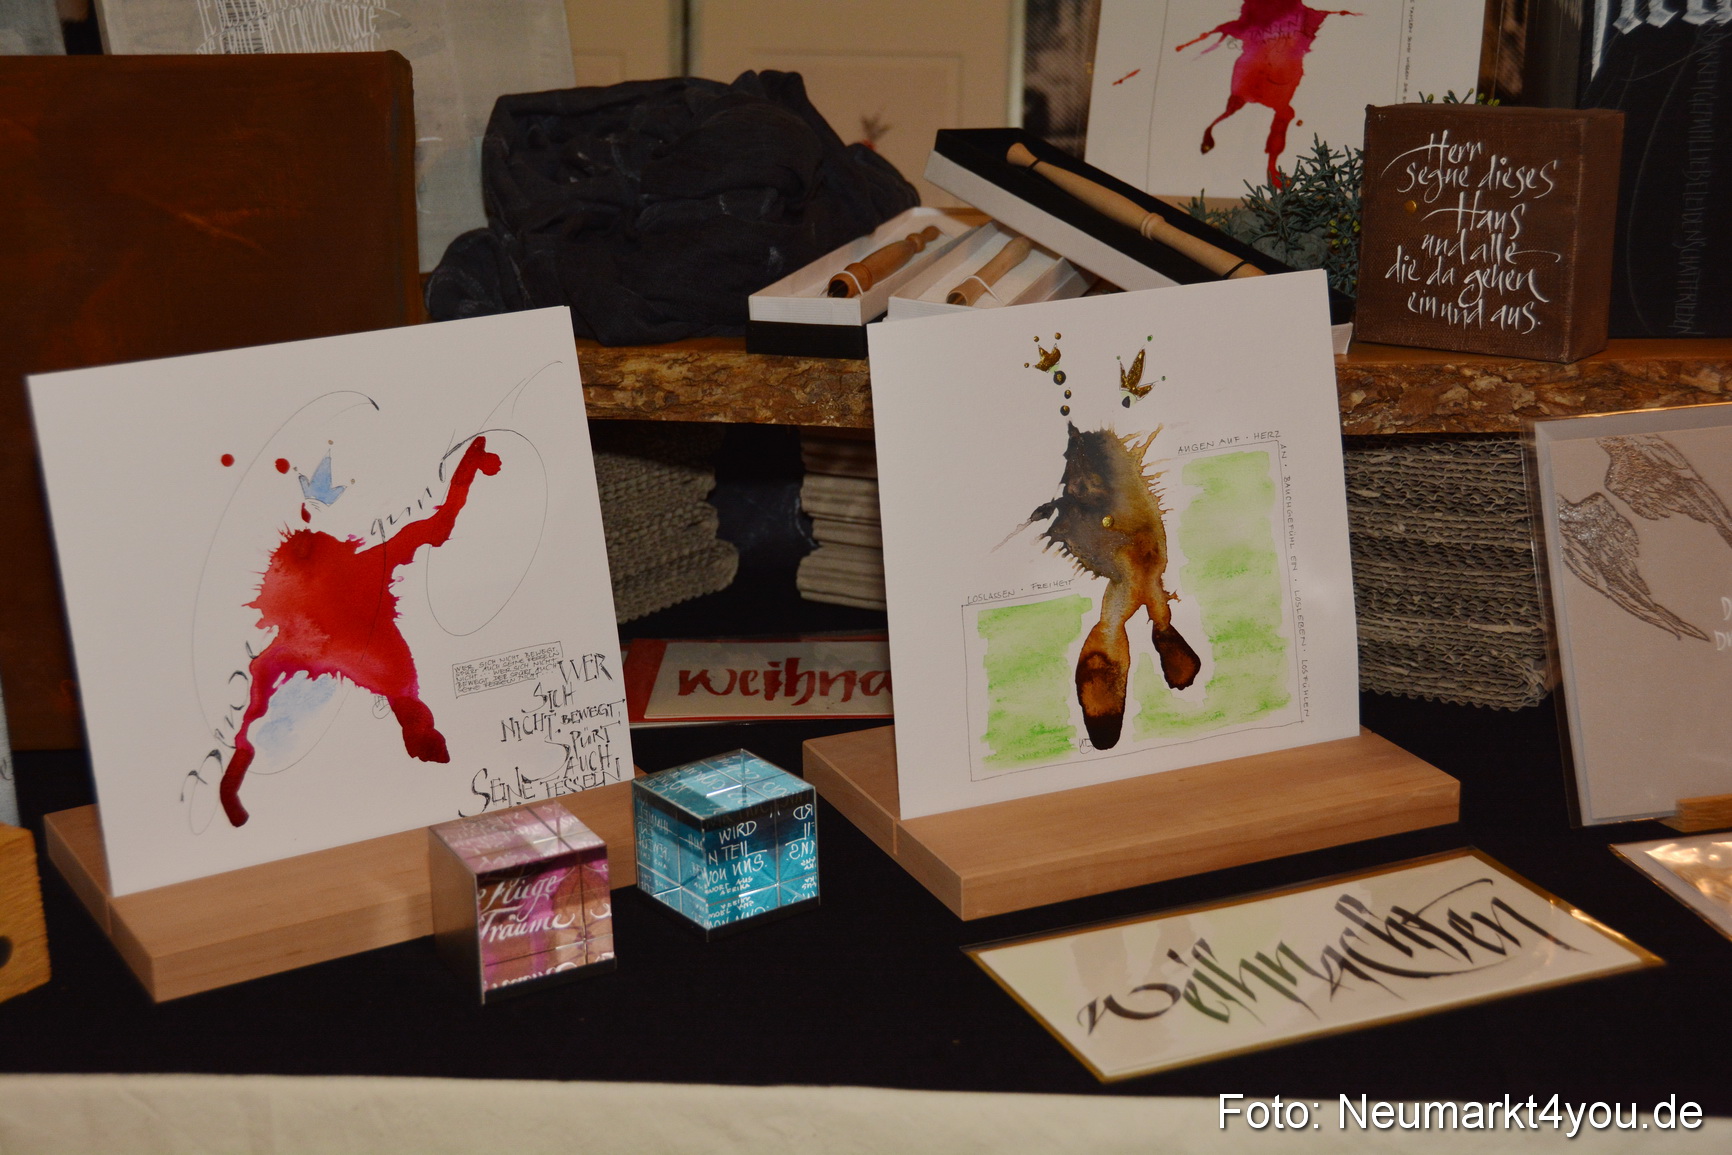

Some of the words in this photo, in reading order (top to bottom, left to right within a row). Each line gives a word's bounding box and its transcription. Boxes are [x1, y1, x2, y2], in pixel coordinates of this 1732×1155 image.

[1381, 130, 1481, 178] Herr
[1397, 162, 1469, 203] segne
[1478, 154, 1557, 198] dieses
[1421, 190, 1525, 240] Haus
[1422, 228, 1465, 265] und
[1470, 233, 1561, 265] alle
[1385, 245, 1420, 283] die
[1426, 256, 1454, 286] da
[1458, 264, 1550, 307] gehen
[1407, 290, 1436, 318] ein
[1441, 298, 1483, 329] und
[1490, 301, 1541, 334] aus.
[1178, 441, 1214, 454] AUGEN
[1220, 436, 1240, 446] AUF
[1254, 430, 1281, 440] HERZ
[967, 590, 1016, 605] LOSLASSEN
[1030, 578, 1075, 590] FREIHEIT
[557, 653, 613, 685] WER
[521, 681, 576, 714] SICH
[564, 743, 612, 779] AUCH
[458, 766, 536, 817] SEINE
[718, 820, 757, 845] WIRD
[721, 840, 768, 862] TEIL
